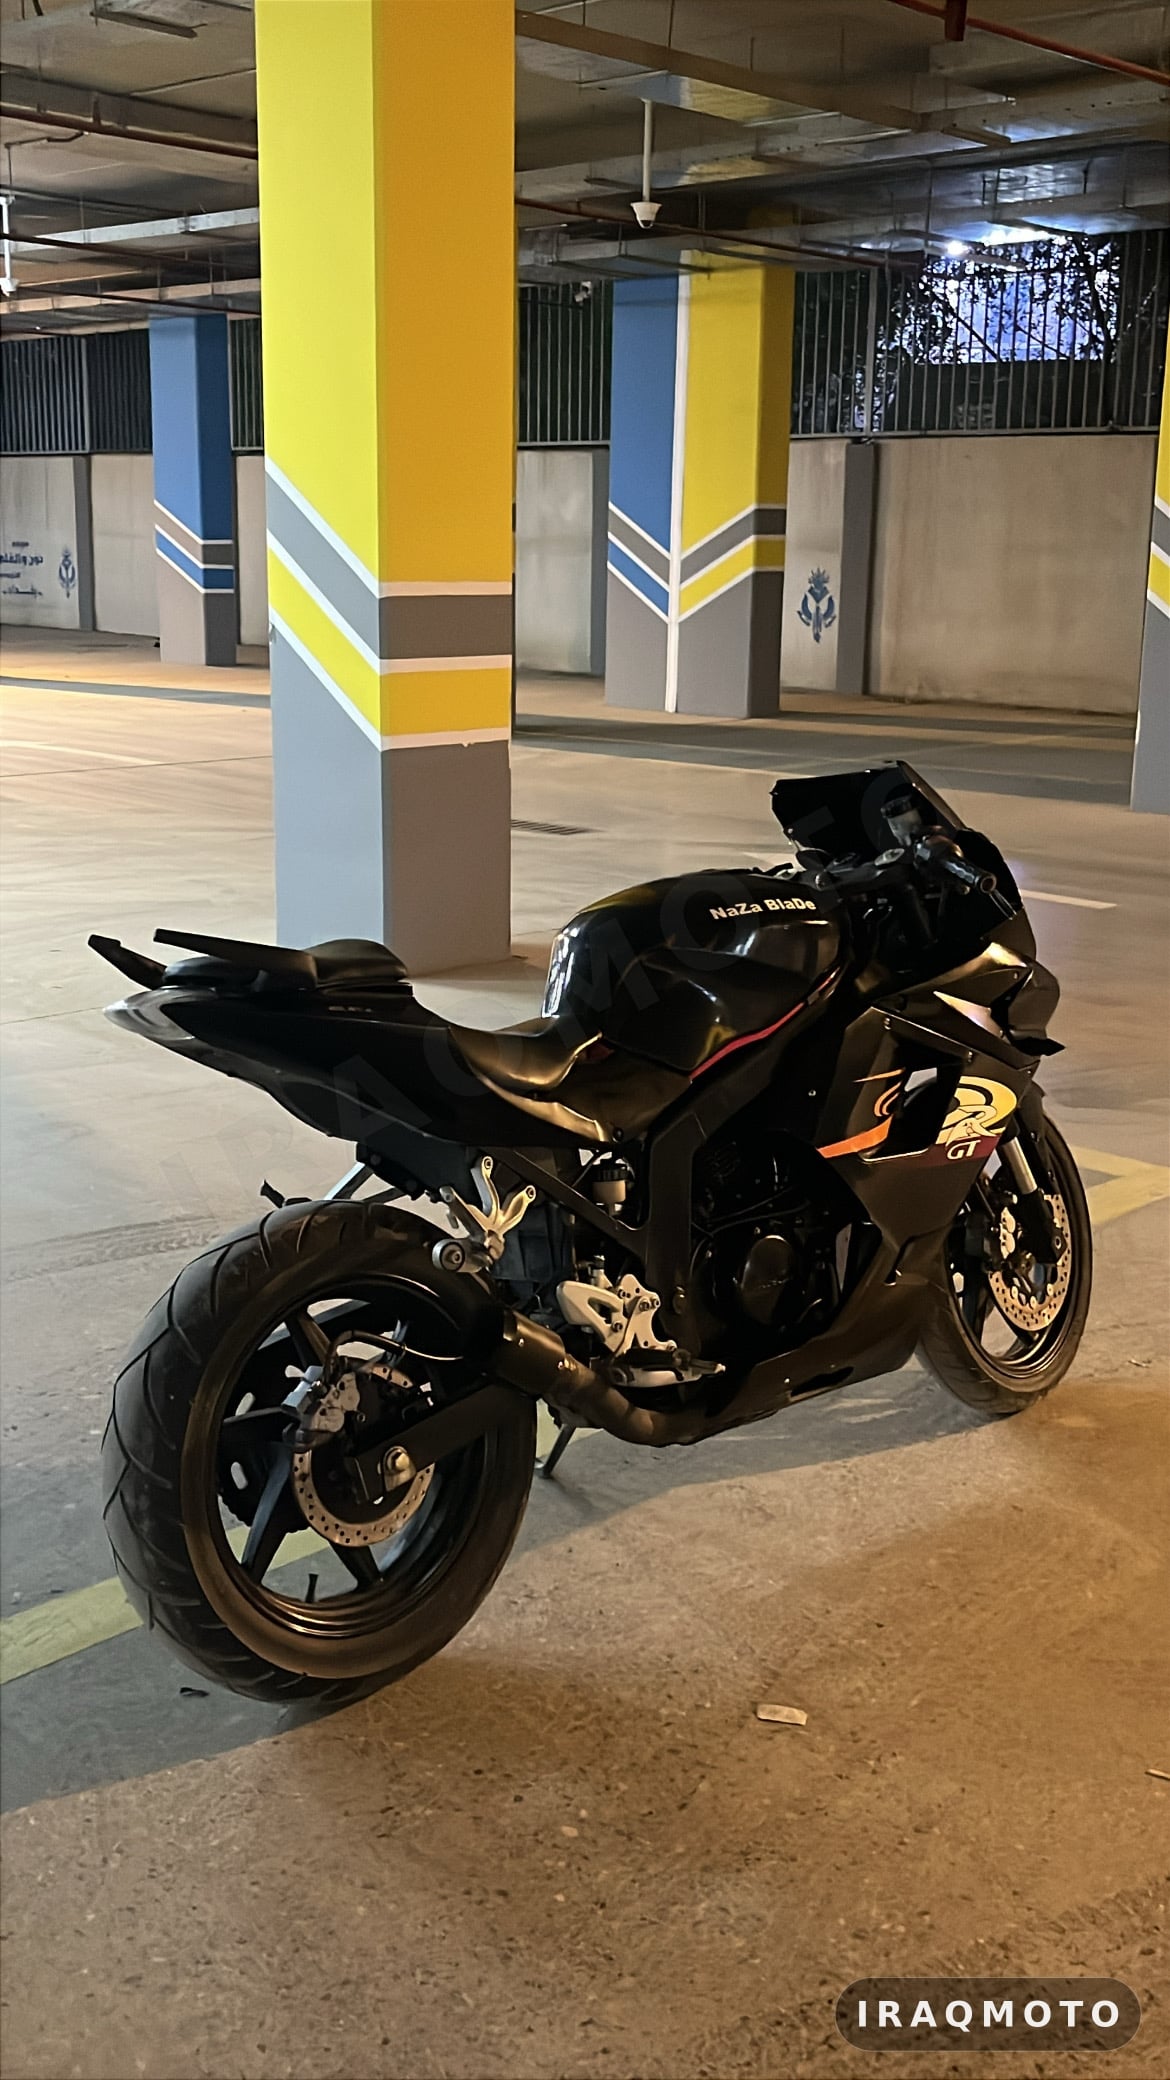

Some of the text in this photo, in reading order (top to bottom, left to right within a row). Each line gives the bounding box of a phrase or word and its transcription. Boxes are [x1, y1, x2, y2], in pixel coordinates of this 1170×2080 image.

[709, 897, 817, 920] NaZa BlaDe
[946, 1139, 982, 1160] GT
